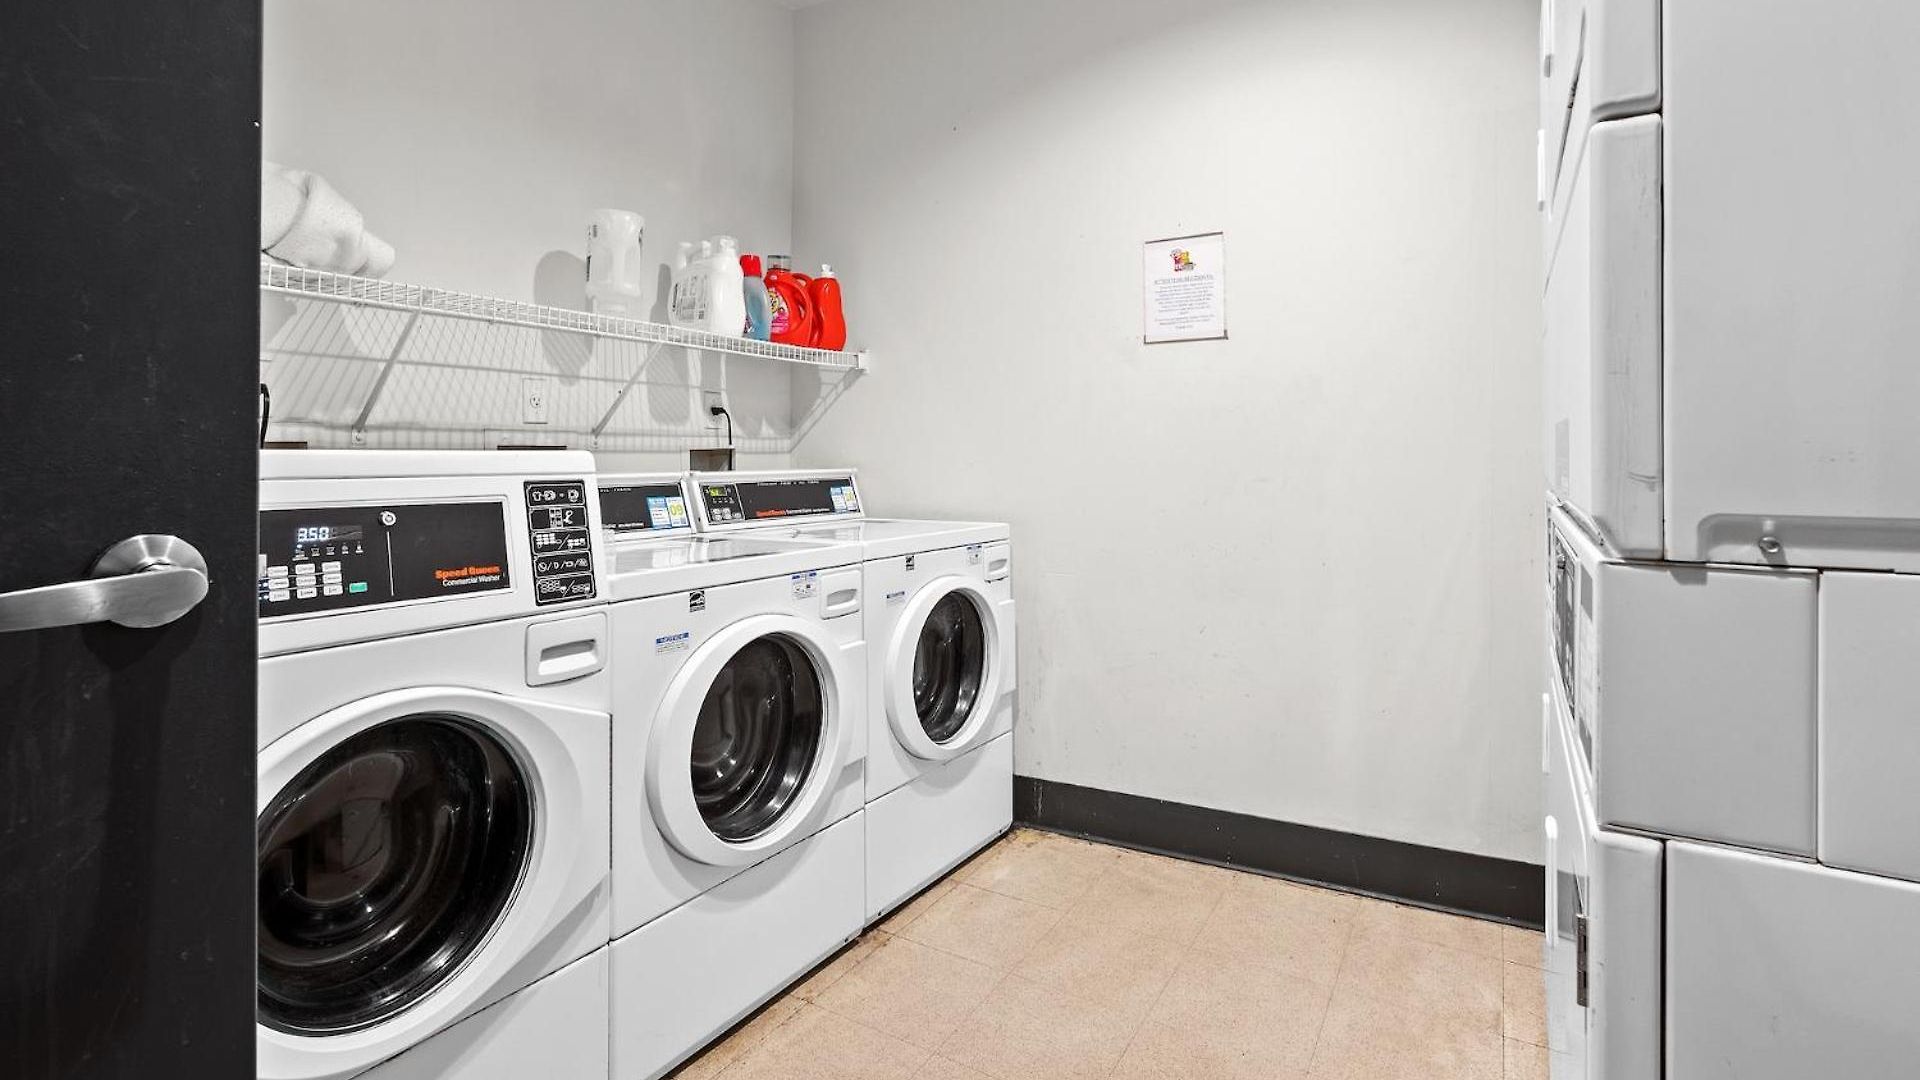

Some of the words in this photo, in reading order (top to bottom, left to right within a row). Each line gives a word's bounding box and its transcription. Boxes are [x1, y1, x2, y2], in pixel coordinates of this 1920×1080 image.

[435, 567, 468, 580] Speed
[442, 577, 478, 587] Commercial
[478, 574, 501, 583] Washer
